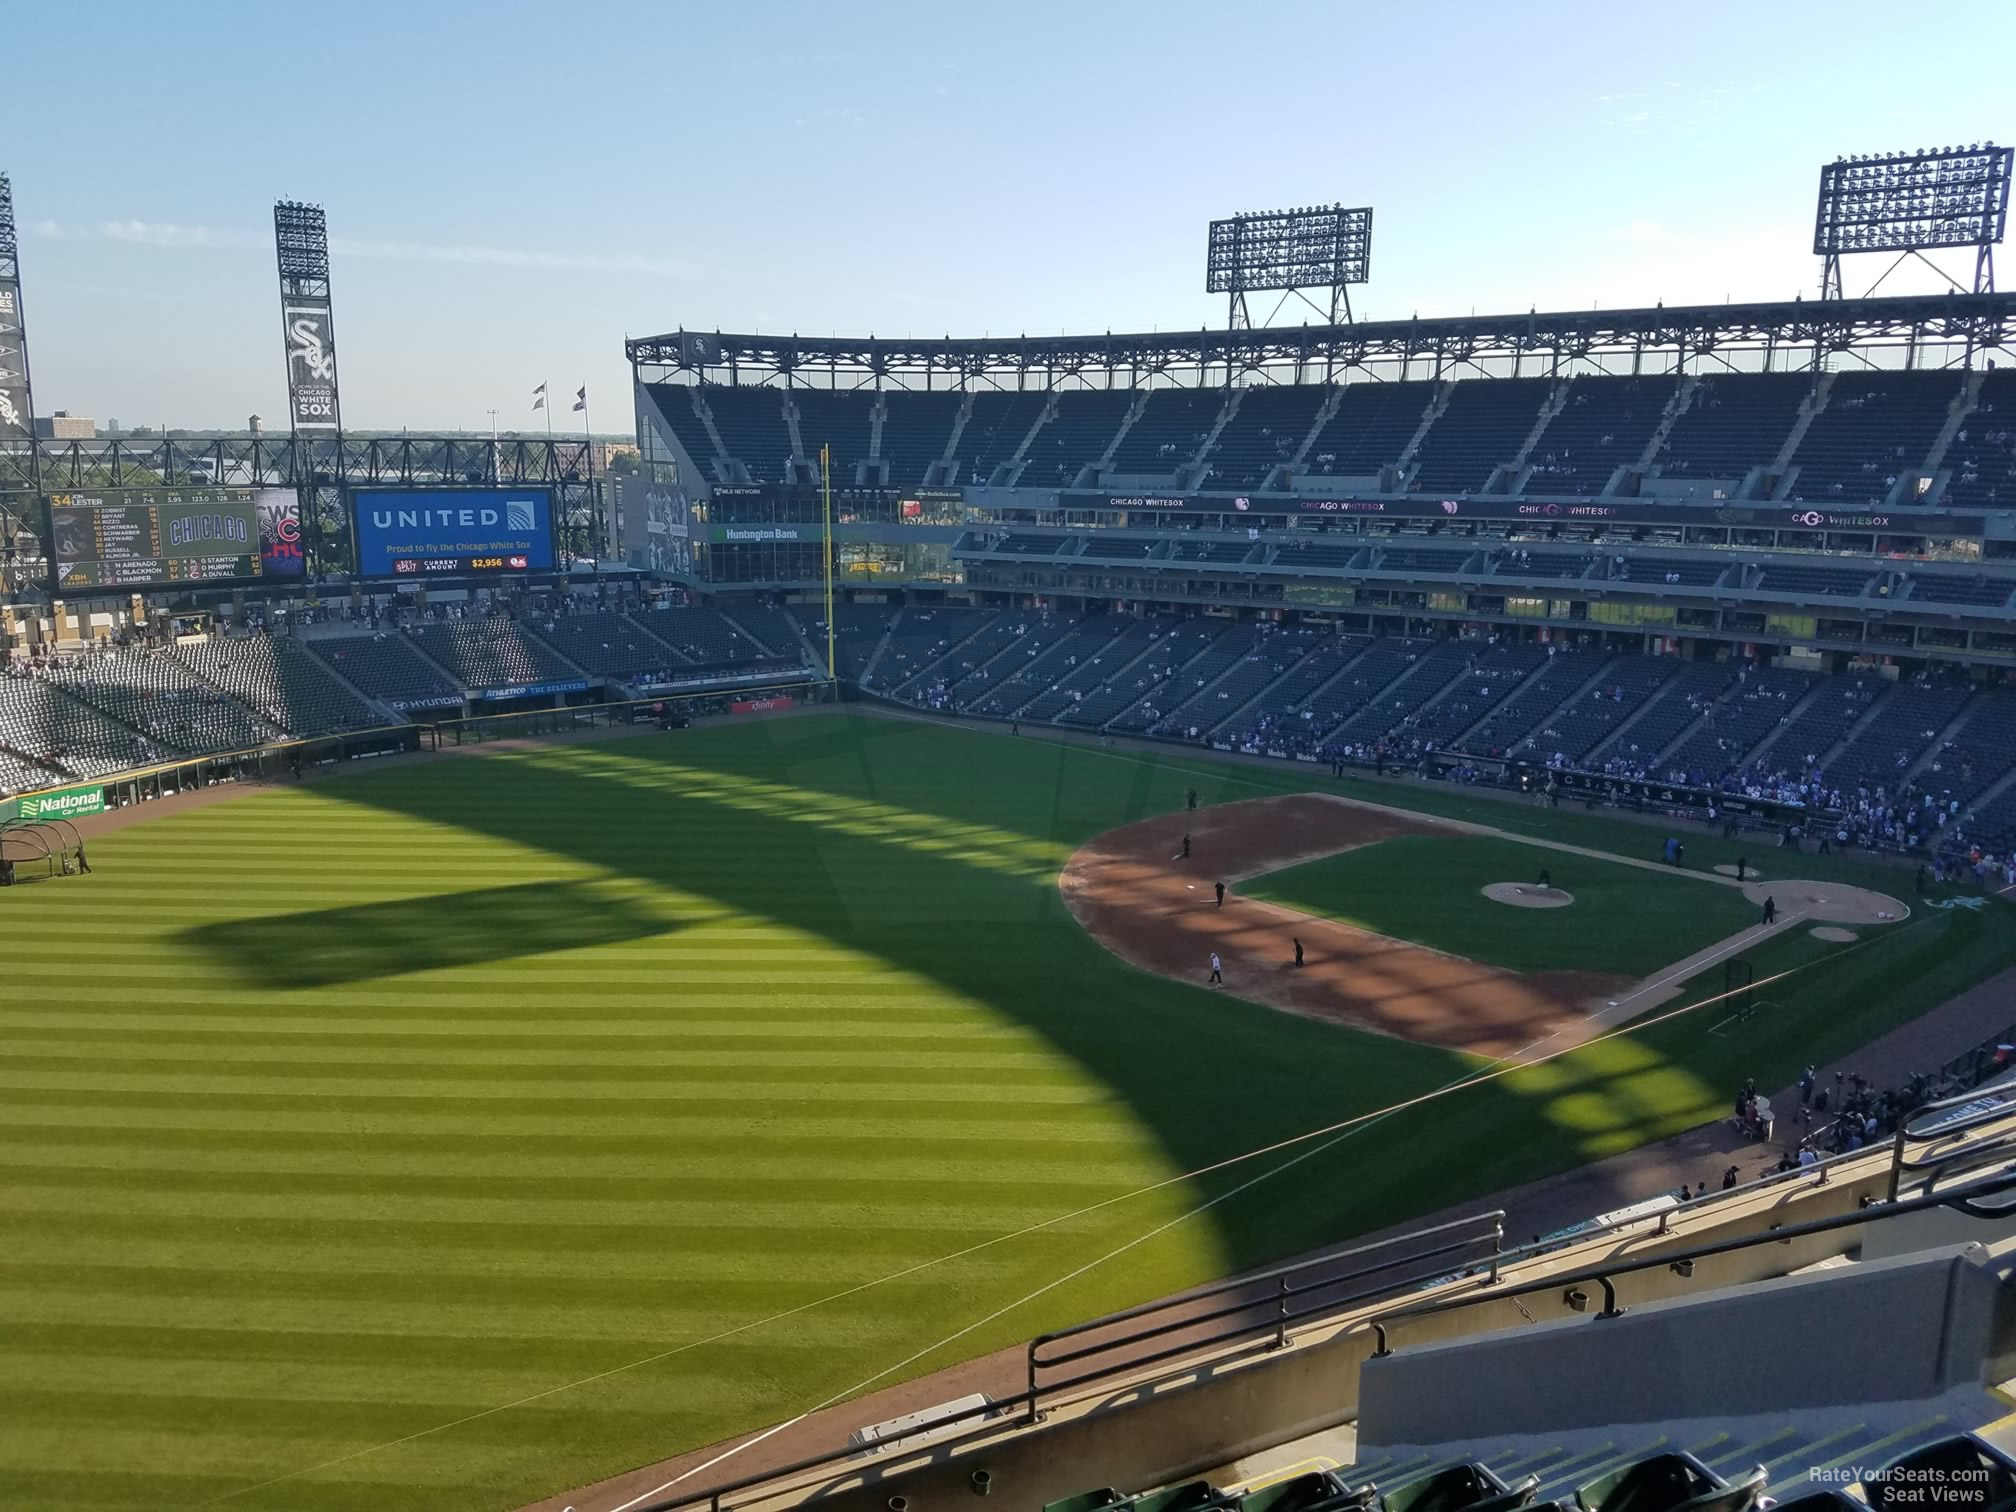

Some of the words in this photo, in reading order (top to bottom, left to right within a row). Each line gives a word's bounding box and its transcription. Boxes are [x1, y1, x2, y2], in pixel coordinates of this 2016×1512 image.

[300, 404, 332, 416] SOX
[52, 495, 71, 506] 34
[1301, 502, 1338, 510] CHICAGO
[373, 509, 498, 528] UNITED
[170, 515, 247, 545] CHICAGO
[726, 529, 774, 541] Huntington
[775, 529, 798, 539] Bank
[386, 545, 413, 553] Proud
[426, 544, 438, 553] fly
[456, 542, 488, 552] Chicago
[490, 541, 514, 549] White
[472, 559, 502, 568] $2,956
[15, 569, 42, 580] 6:11
[486, 687, 526, 698] ATHLETICO
[547, 683, 586, 693] RELIEVERS
[410, 696, 463, 708] HYUNDAI
[752, 701, 775, 711] xfinity
[1214, 741, 1231, 750] Modelo
[1241, 745, 1258, 754] Modelo
[1268, 748, 1286, 758] Modelo
[1296, 752, 1317, 762] Modelo
[40, 790, 101, 812] National
[76, 804, 99, 813] Rental
